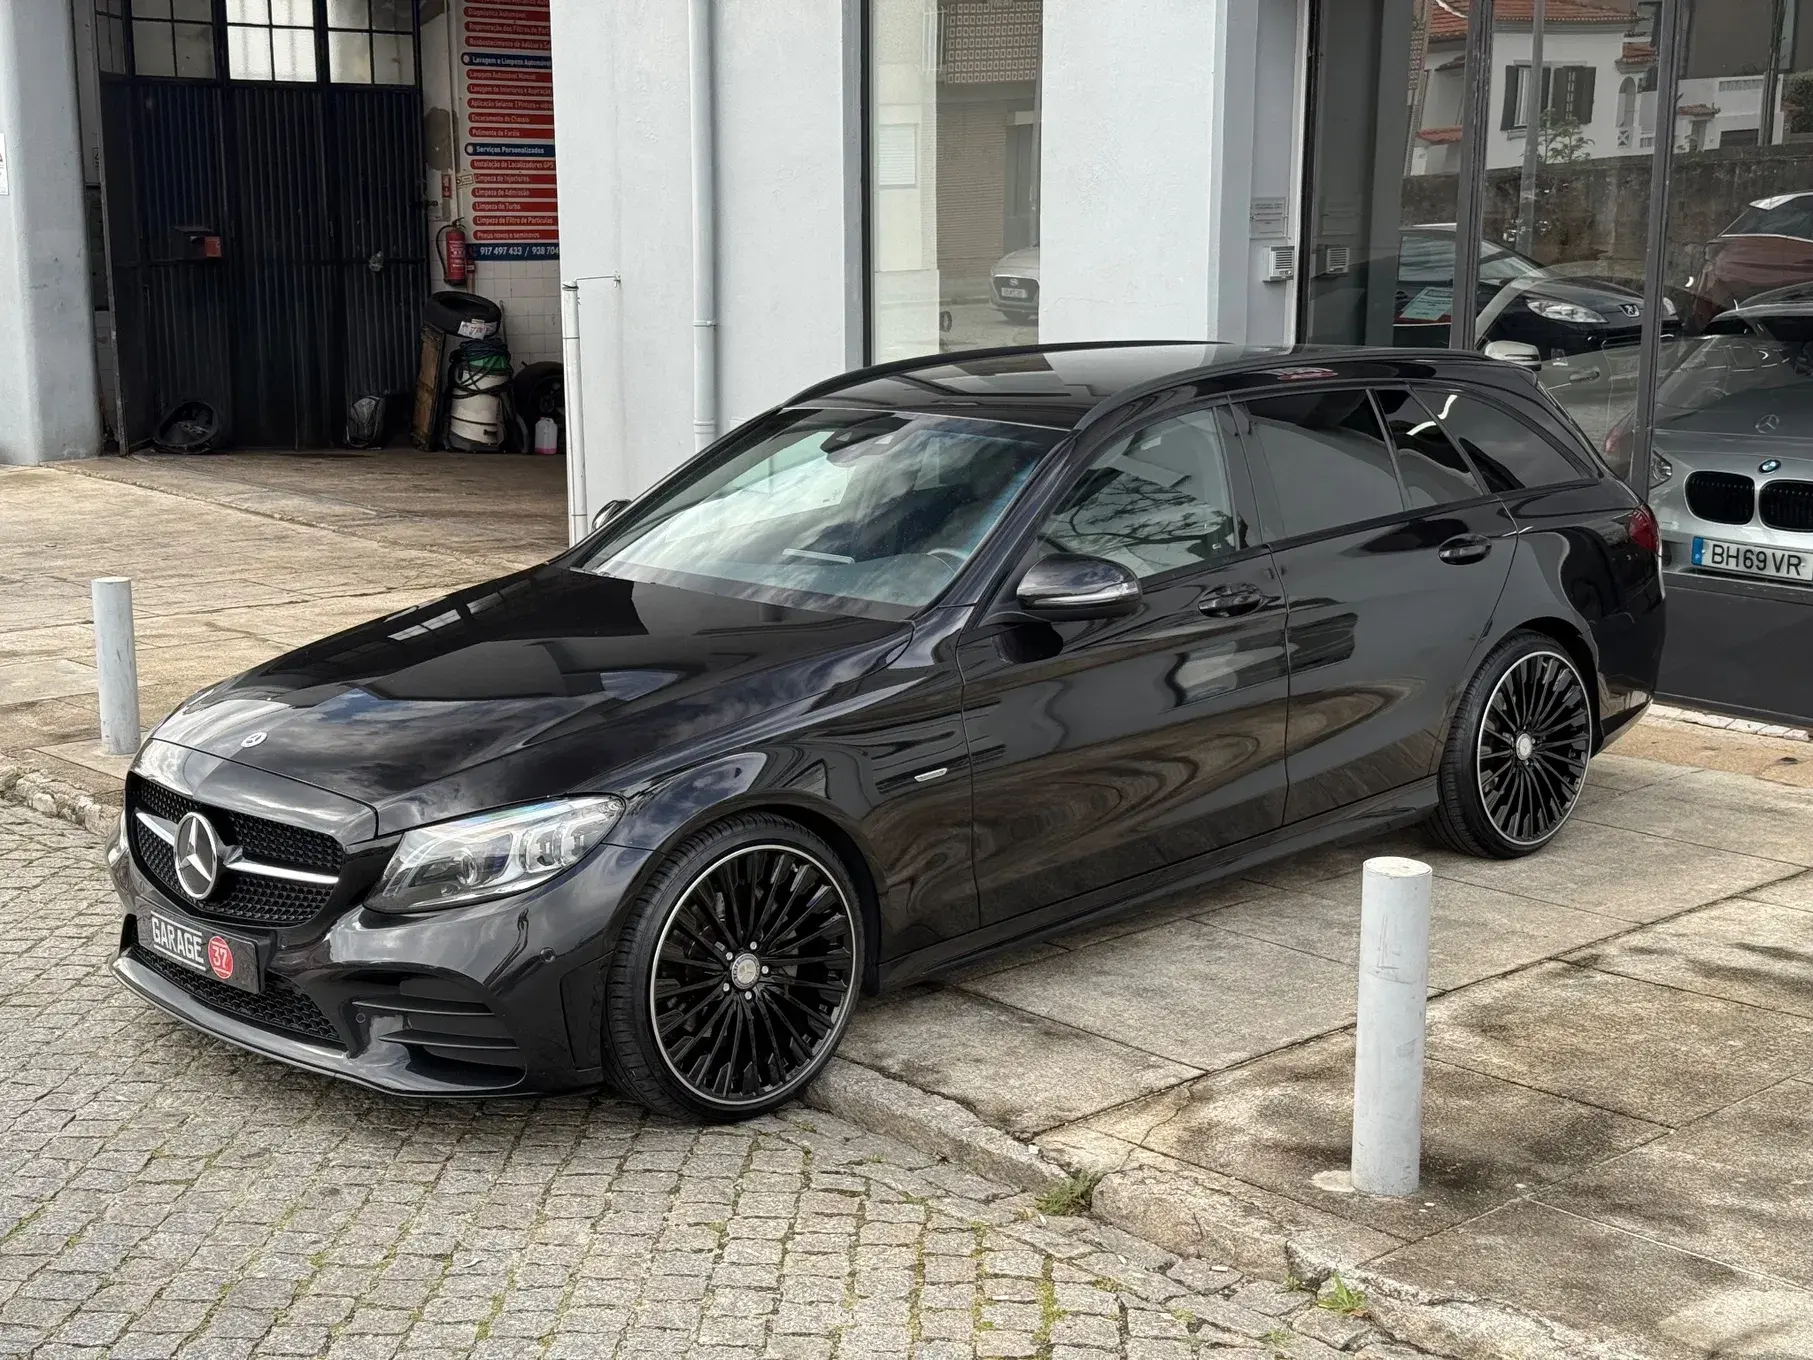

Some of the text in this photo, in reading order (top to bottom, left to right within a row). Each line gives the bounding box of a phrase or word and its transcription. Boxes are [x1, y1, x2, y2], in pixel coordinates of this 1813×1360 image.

[472, 56, 496, 65] Lavagem
[470, 71, 492, 79] Lavagem
[476, 146, 500, 154] Serviços
[480, 247, 491, 255] 917
[494, 247, 507, 255] 497
[508, 247, 522, 255] 433
[532, 247, 545, 255] 938
[1712, 544, 1802, 576] BH 69 VR
[151, 916, 228, 968] GARAGE 37
